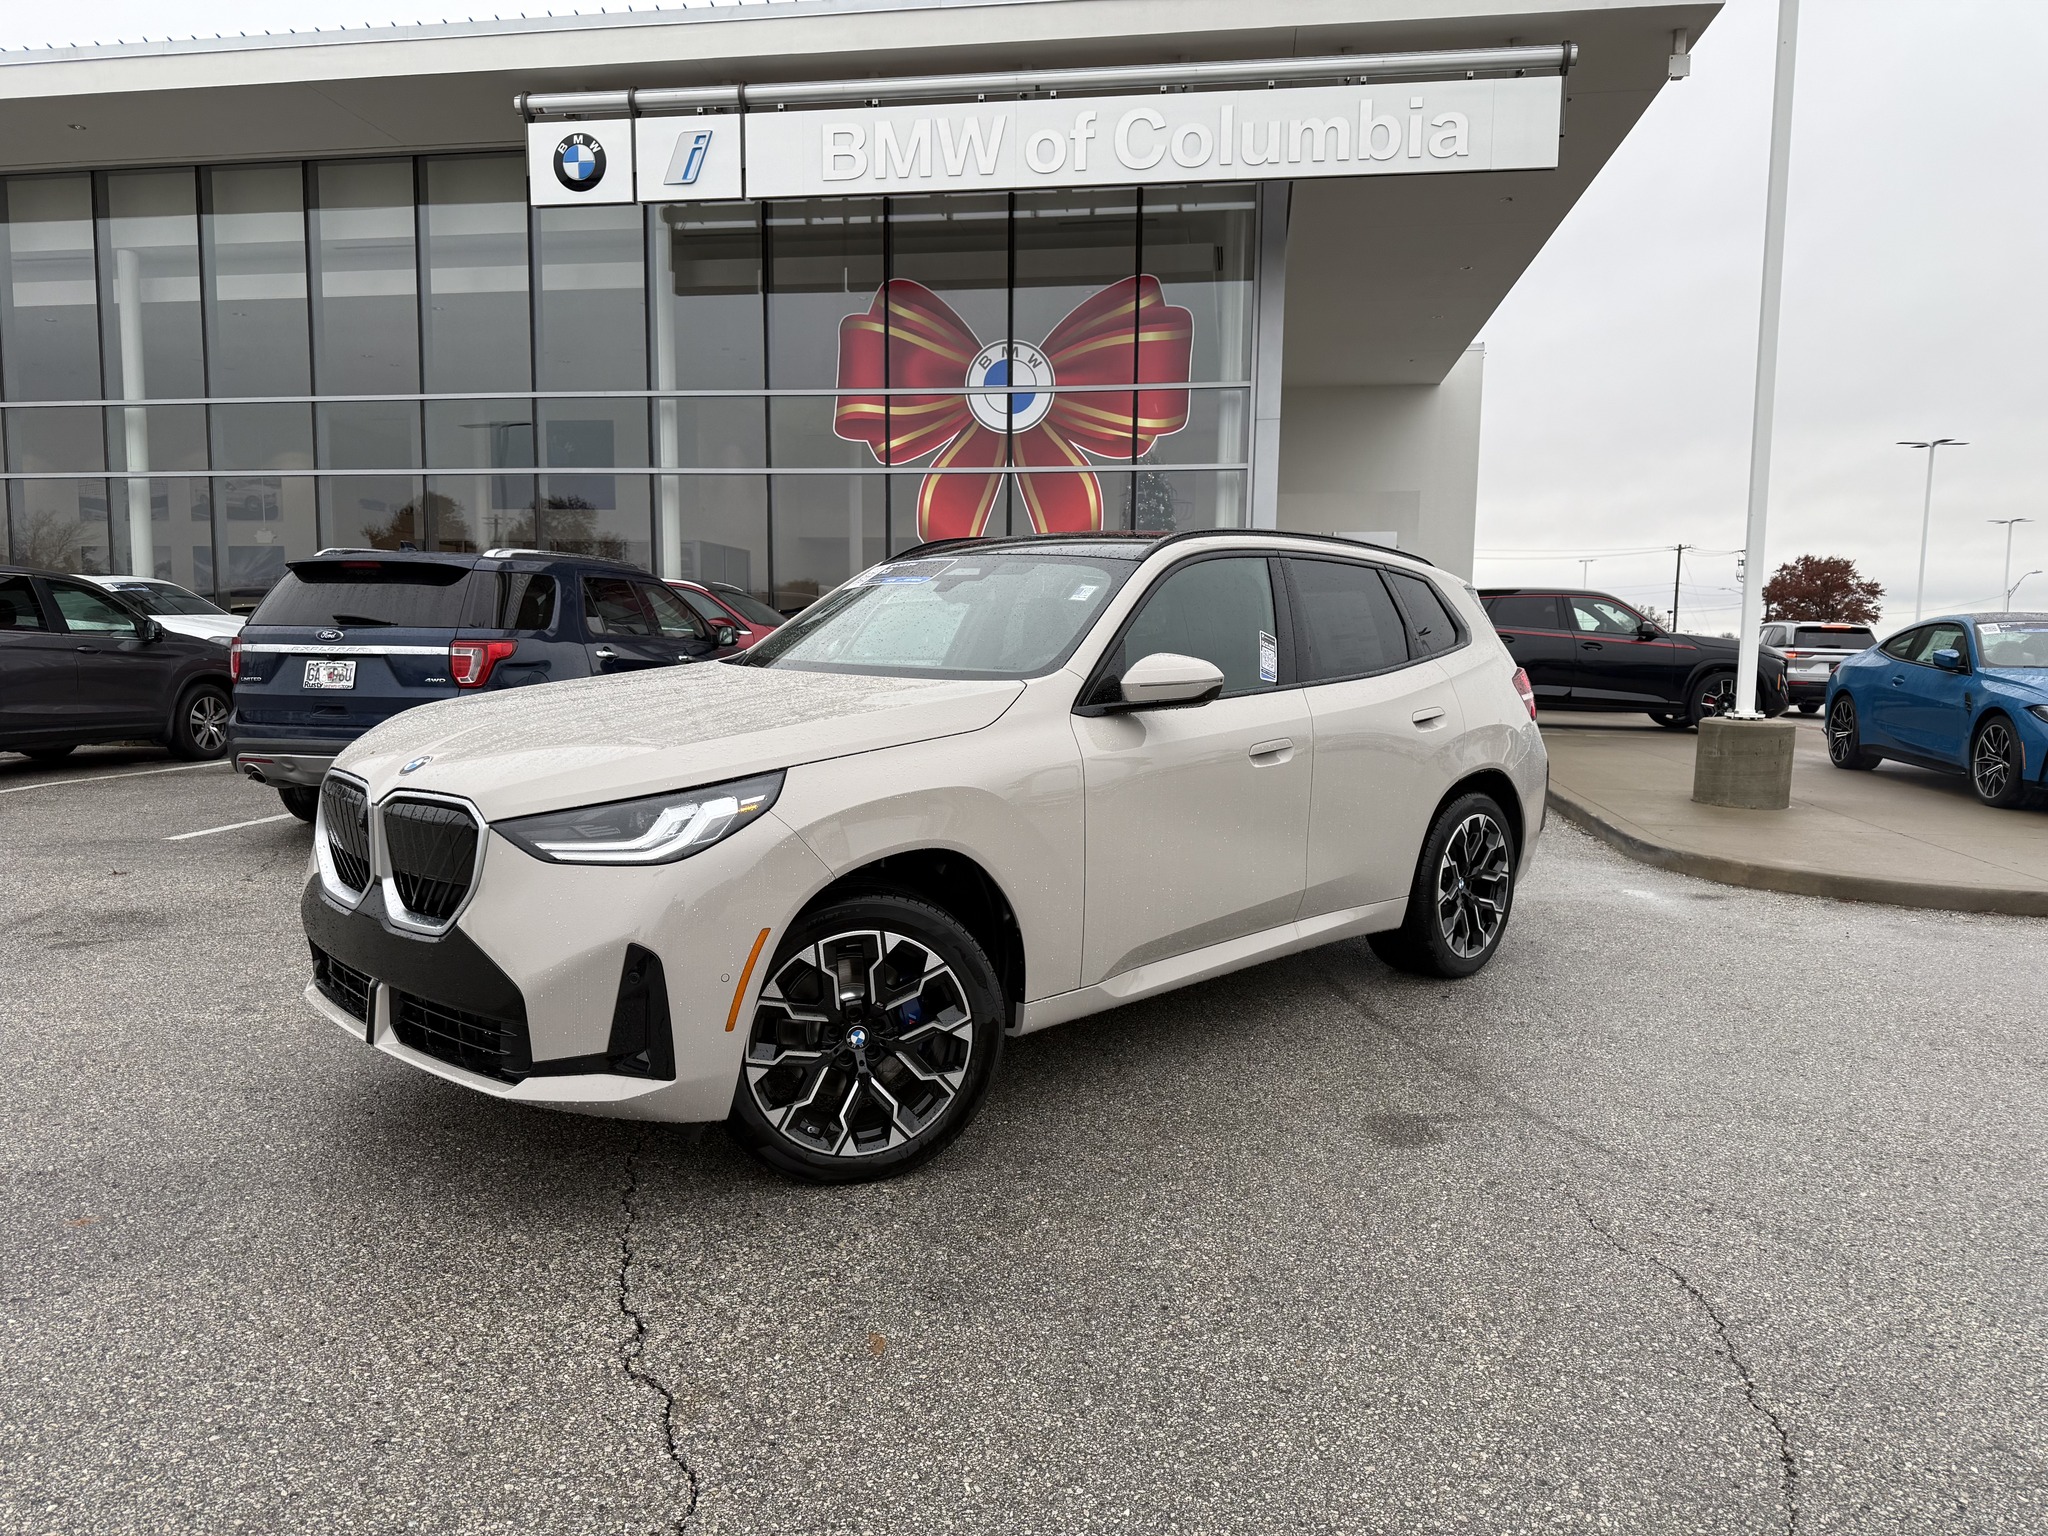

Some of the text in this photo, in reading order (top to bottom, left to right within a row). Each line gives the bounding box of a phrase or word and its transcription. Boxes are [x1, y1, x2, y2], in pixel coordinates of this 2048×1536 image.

[557, 134, 601, 154] BMW
[821, 96, 1470, 182] BMW of Columbia
[978, 346, 1042, 370] BMW
[320, 631, 337, 639] Ford
